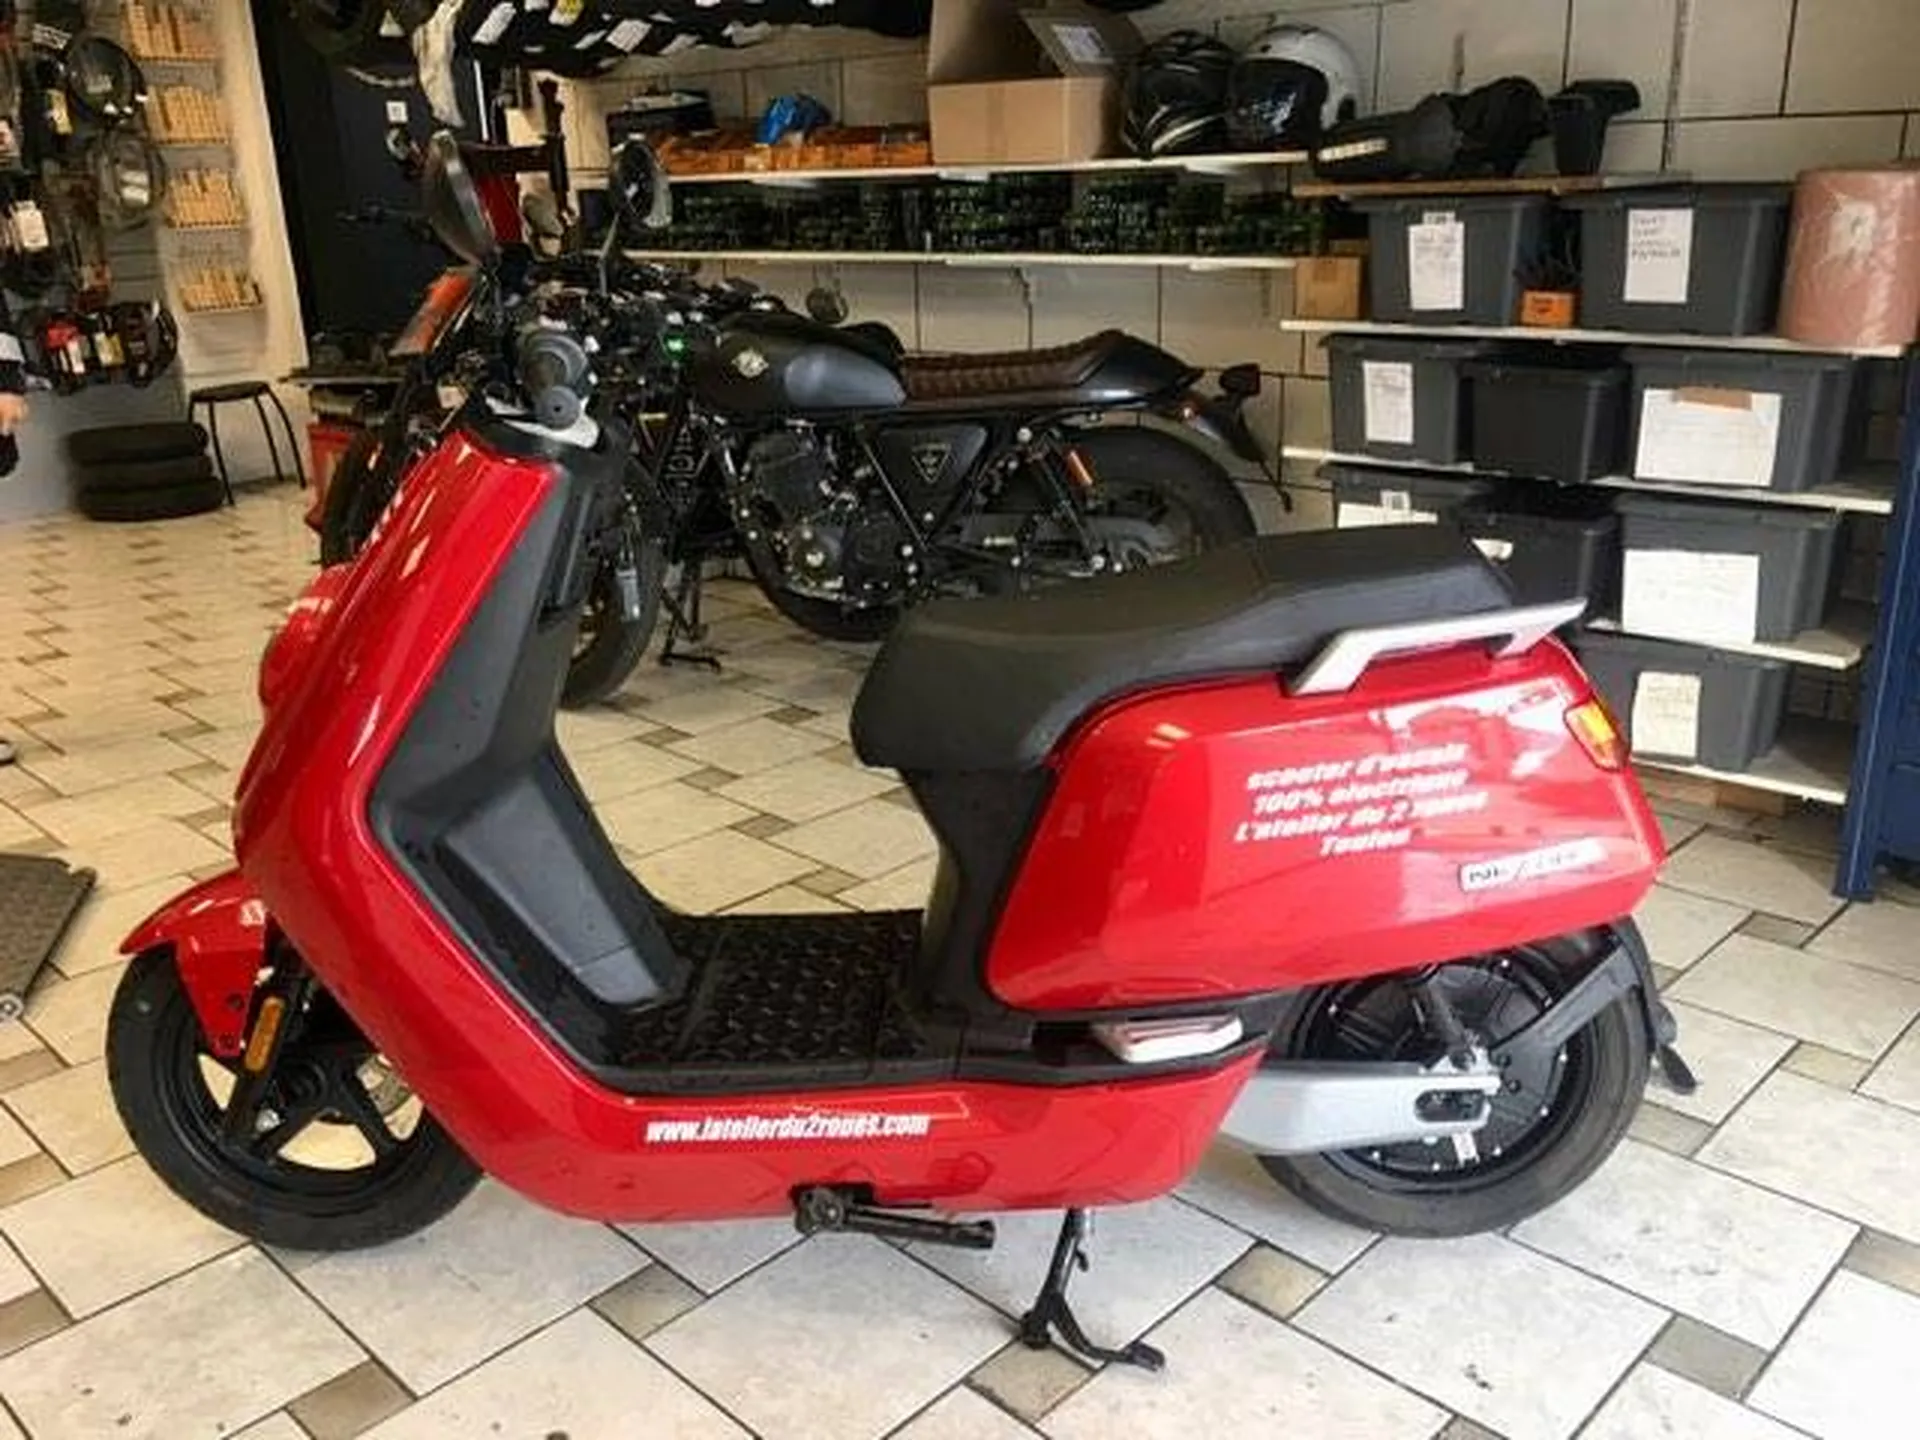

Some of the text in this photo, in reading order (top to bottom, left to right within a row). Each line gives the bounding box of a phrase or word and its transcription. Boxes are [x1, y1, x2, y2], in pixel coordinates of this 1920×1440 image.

[1247, 762, 1353, 790] scooter
[1253, 787, 1323, 815] 100%
[1388, 798, 1410, 821] 2
